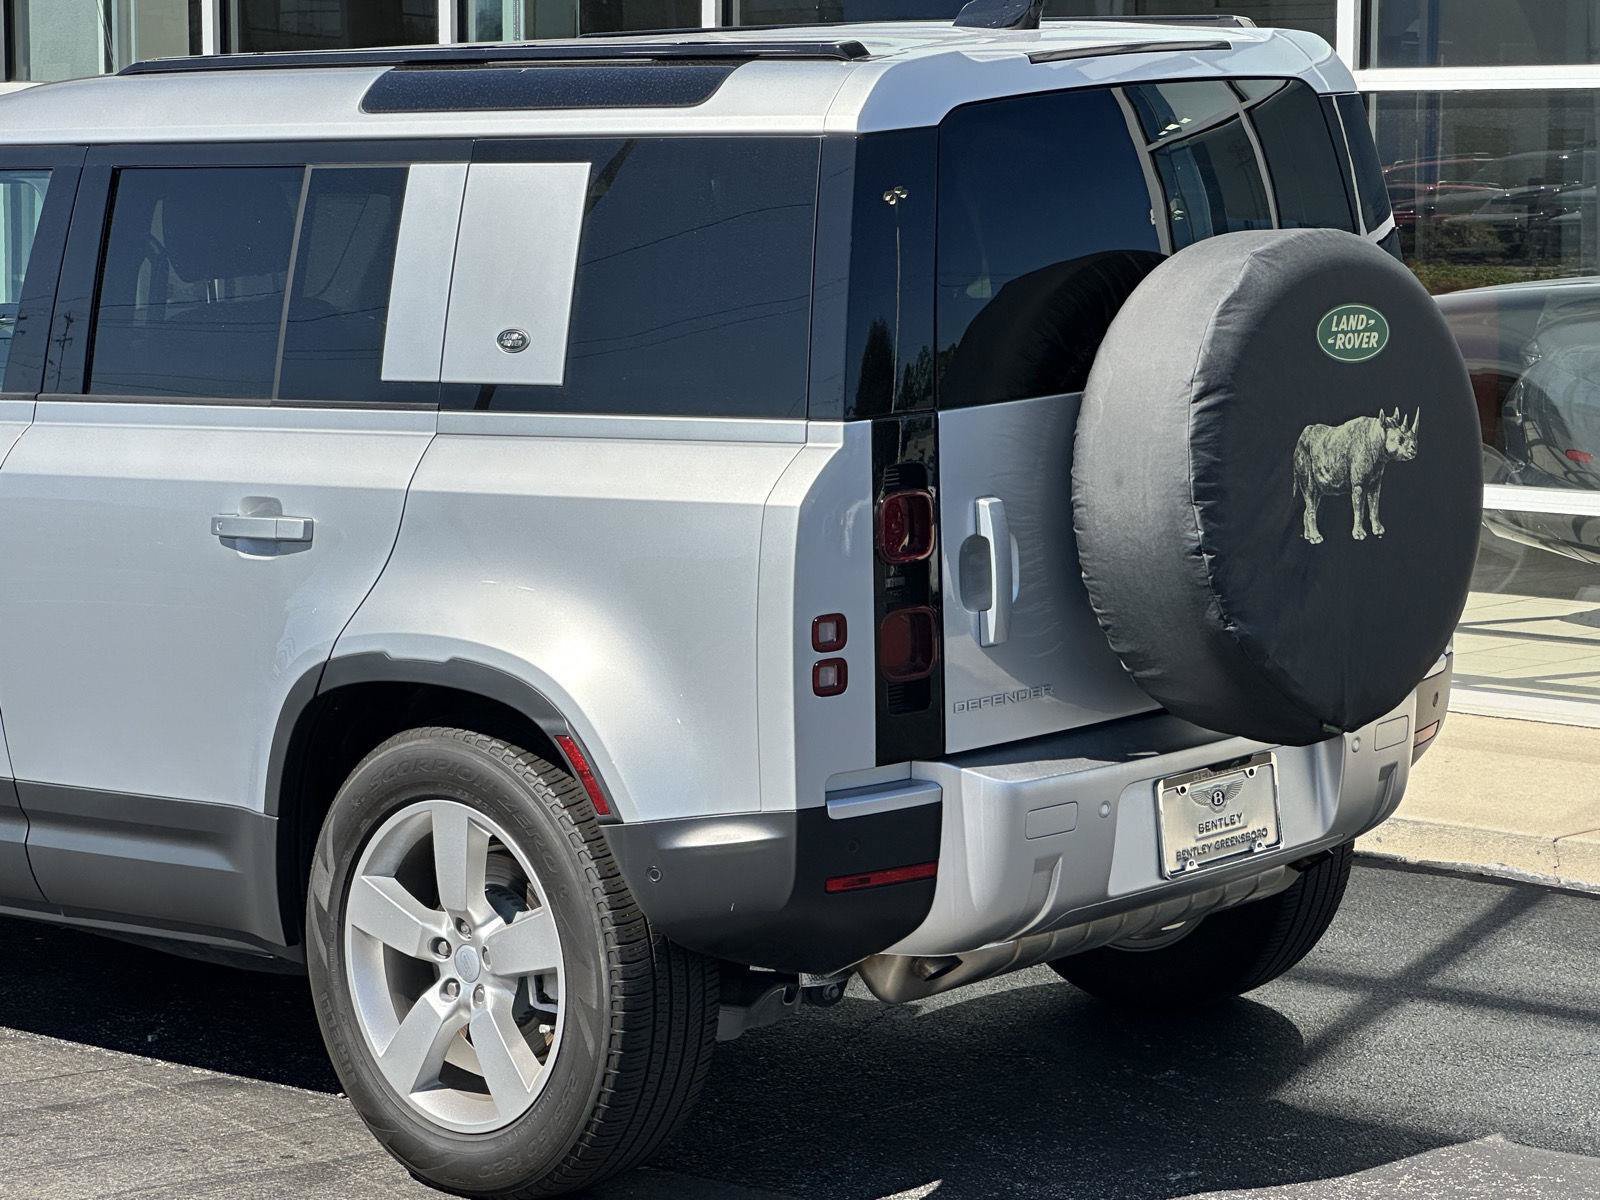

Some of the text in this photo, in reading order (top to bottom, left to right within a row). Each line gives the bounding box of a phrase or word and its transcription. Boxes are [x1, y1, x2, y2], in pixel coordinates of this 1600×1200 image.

[953, 684, 1055, 714] DEFENDER
[1198, 812, 1243, 835] BENTLEY
[1176, 827, 1268, 861] BENTLEY GREENSBORO
